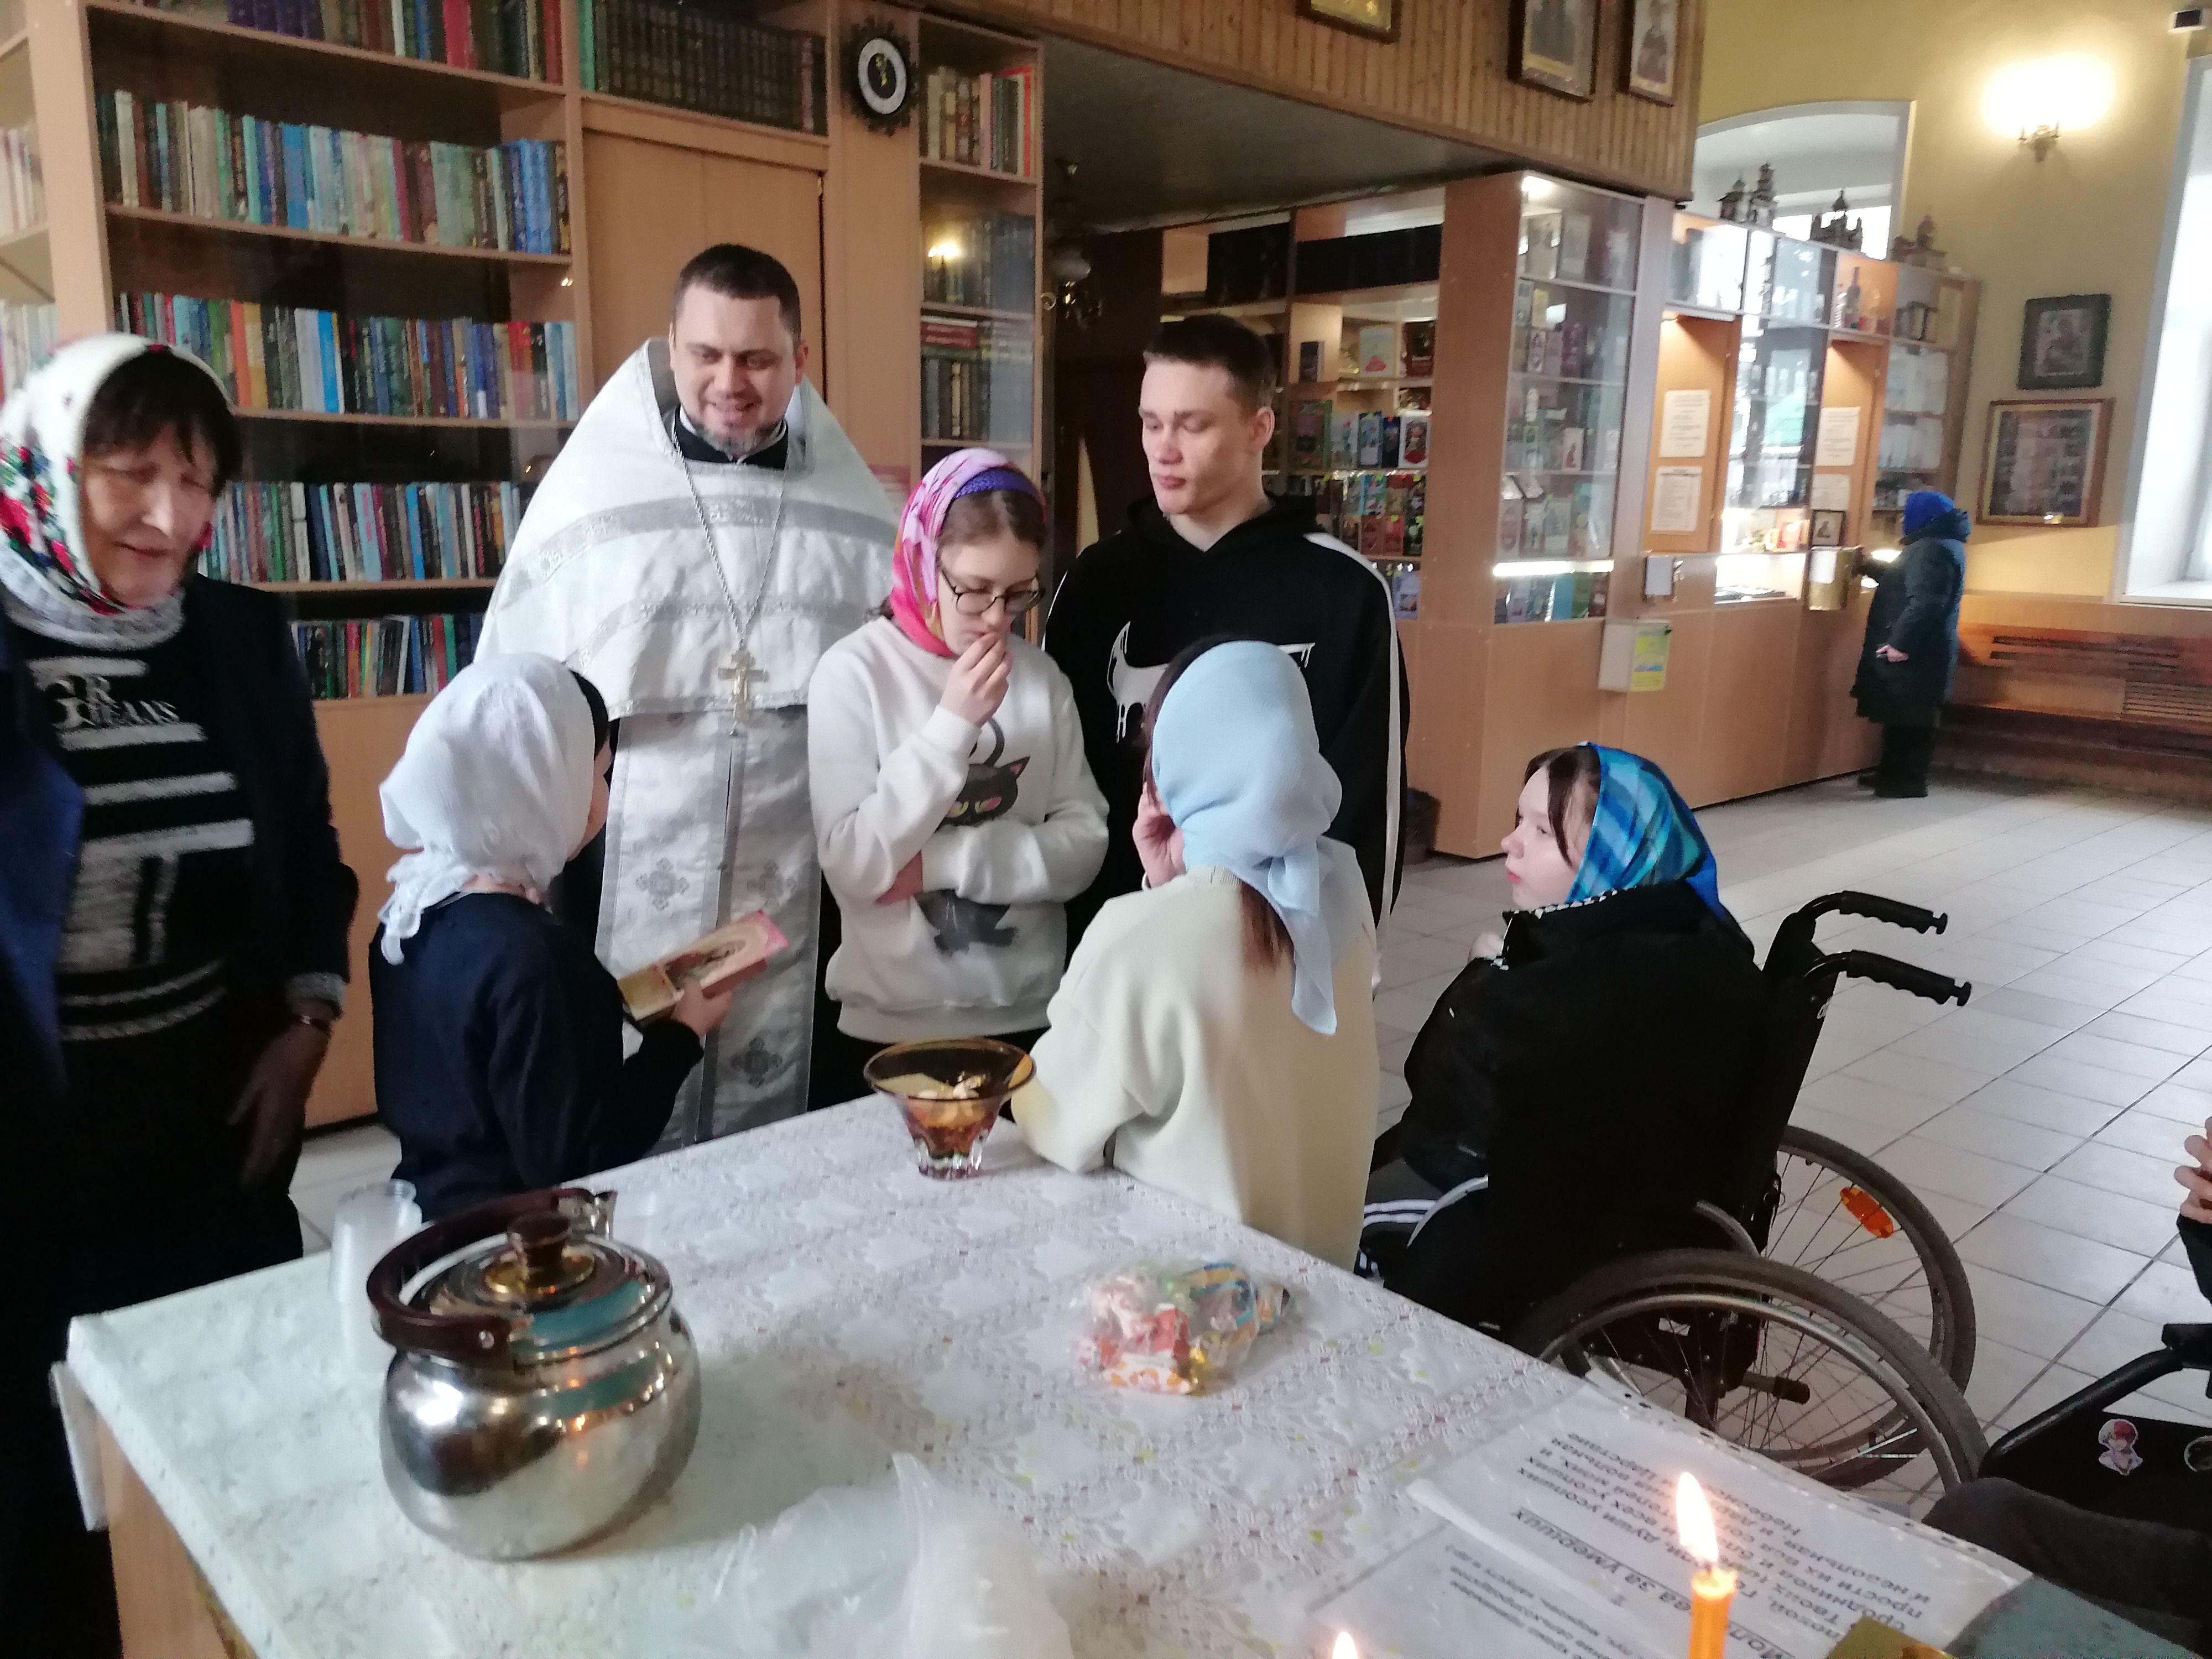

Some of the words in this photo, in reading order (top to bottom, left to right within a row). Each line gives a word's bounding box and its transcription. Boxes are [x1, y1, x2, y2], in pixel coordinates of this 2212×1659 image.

[1540, 1447, 1553, 1457] и
[1601, 1511, 1661, 1546] души
[1759, 1527, 1773, 1536] и
[1509, 1506, 1623, 1574] умерших
[1759, 1558, 1773, 1569] и
[1623, 1571, 1656, 1594] за
[1804, 1566, 1832, 1583] их
[1837, 1578, 1923, 1620] прости
[1913, 1593, 1931, 1605] и
[1763, 1595, 1841, 1641] покой,
